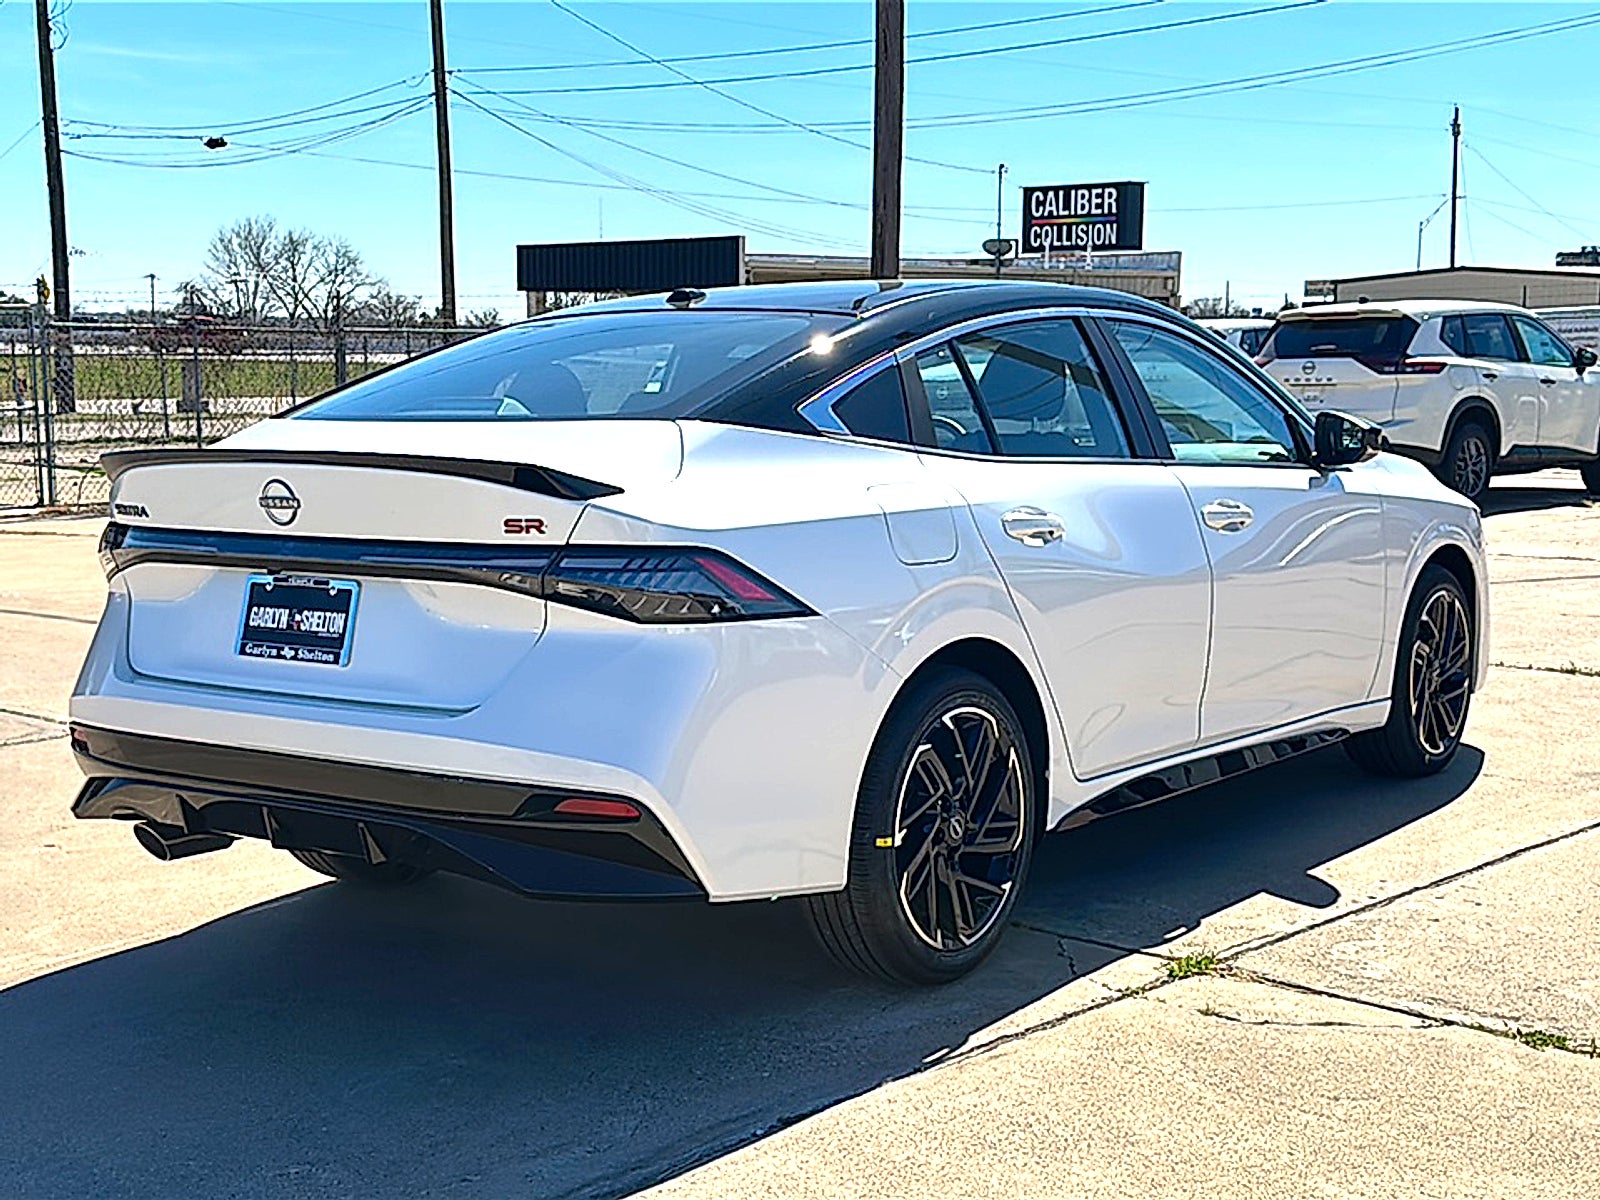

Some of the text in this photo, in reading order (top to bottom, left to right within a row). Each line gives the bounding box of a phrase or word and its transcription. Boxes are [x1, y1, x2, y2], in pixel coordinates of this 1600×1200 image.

[1031, 187, 1118, 217] CALIBER
[1030, 223, 1118, 247] COLLISION
[503, 518, 546, 534] SR
[249, 606, 346, 633] GARLYN SHELTON
[245, 643, 335, 662] Garlyn Shelton
